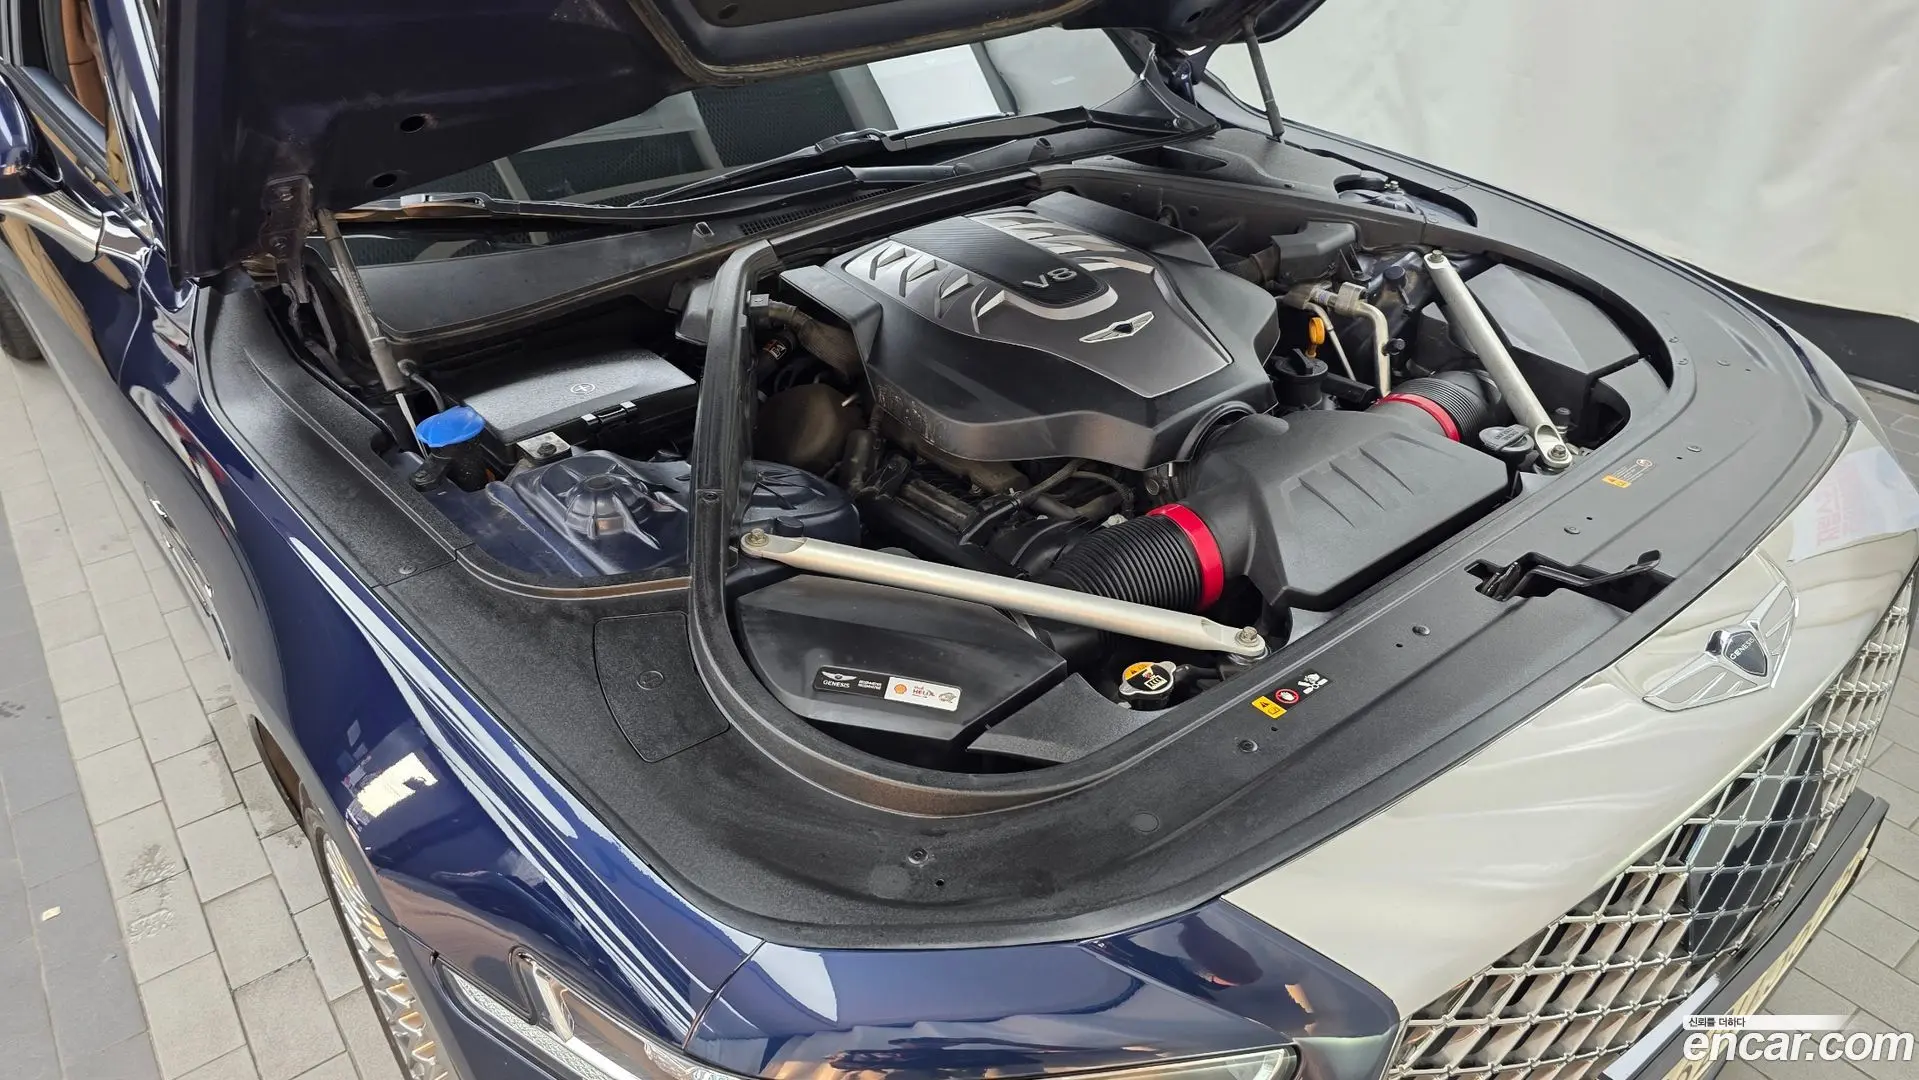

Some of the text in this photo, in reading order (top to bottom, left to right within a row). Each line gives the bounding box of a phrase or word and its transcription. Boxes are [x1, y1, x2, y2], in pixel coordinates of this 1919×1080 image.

[1022, 267, 1077, 288] V8
[1729, 637, 1755, 660] GENESIS
[822, 680, 850, 689] GENESIS
